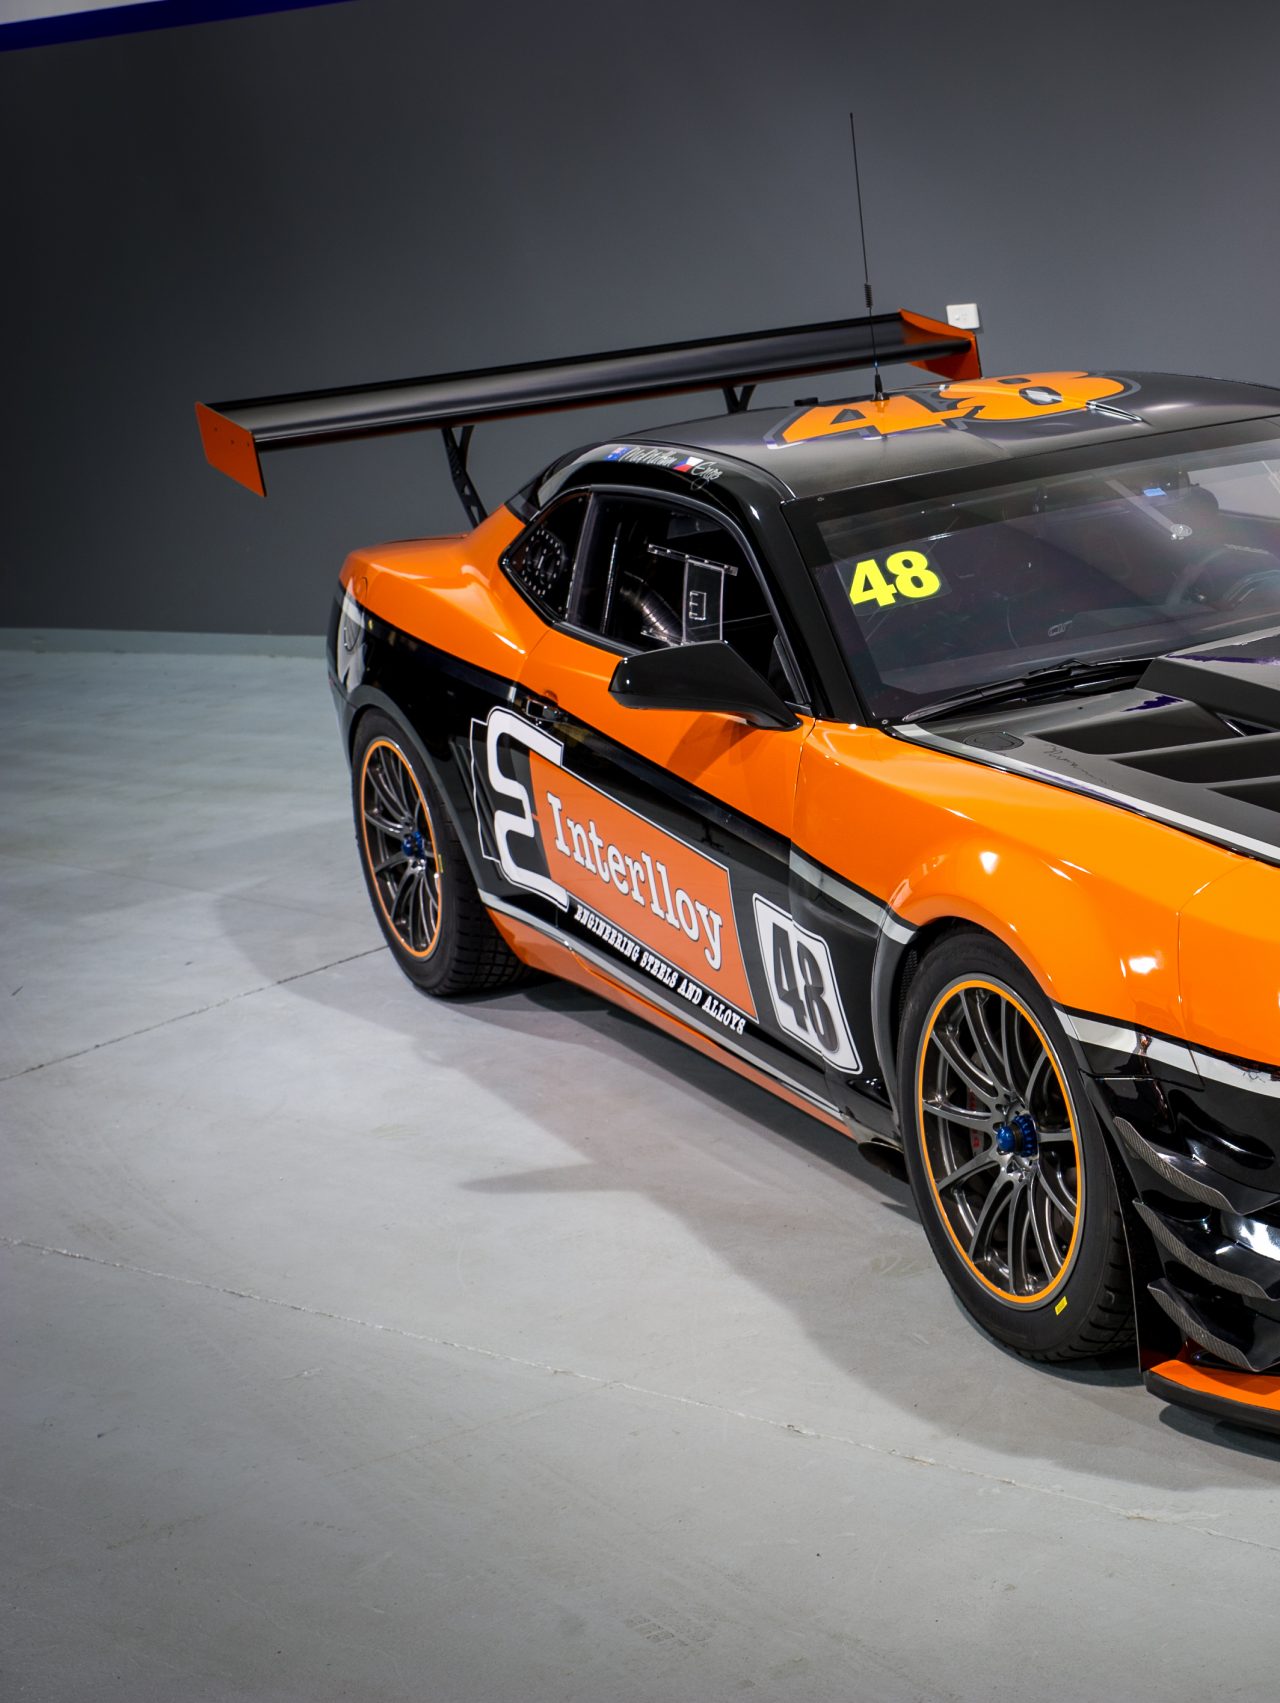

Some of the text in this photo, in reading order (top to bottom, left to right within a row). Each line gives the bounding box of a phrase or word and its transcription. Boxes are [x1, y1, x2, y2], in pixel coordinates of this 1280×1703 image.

[768, 370, 1138, 448] 48
[849, 550, 941, 607] 48
[546, 790, 723, 971] Interlloy
[574, 904, 747, 1036] ENGINEERING STEELS AND ALLOYS
[771, 921, 841, 1055] 48
